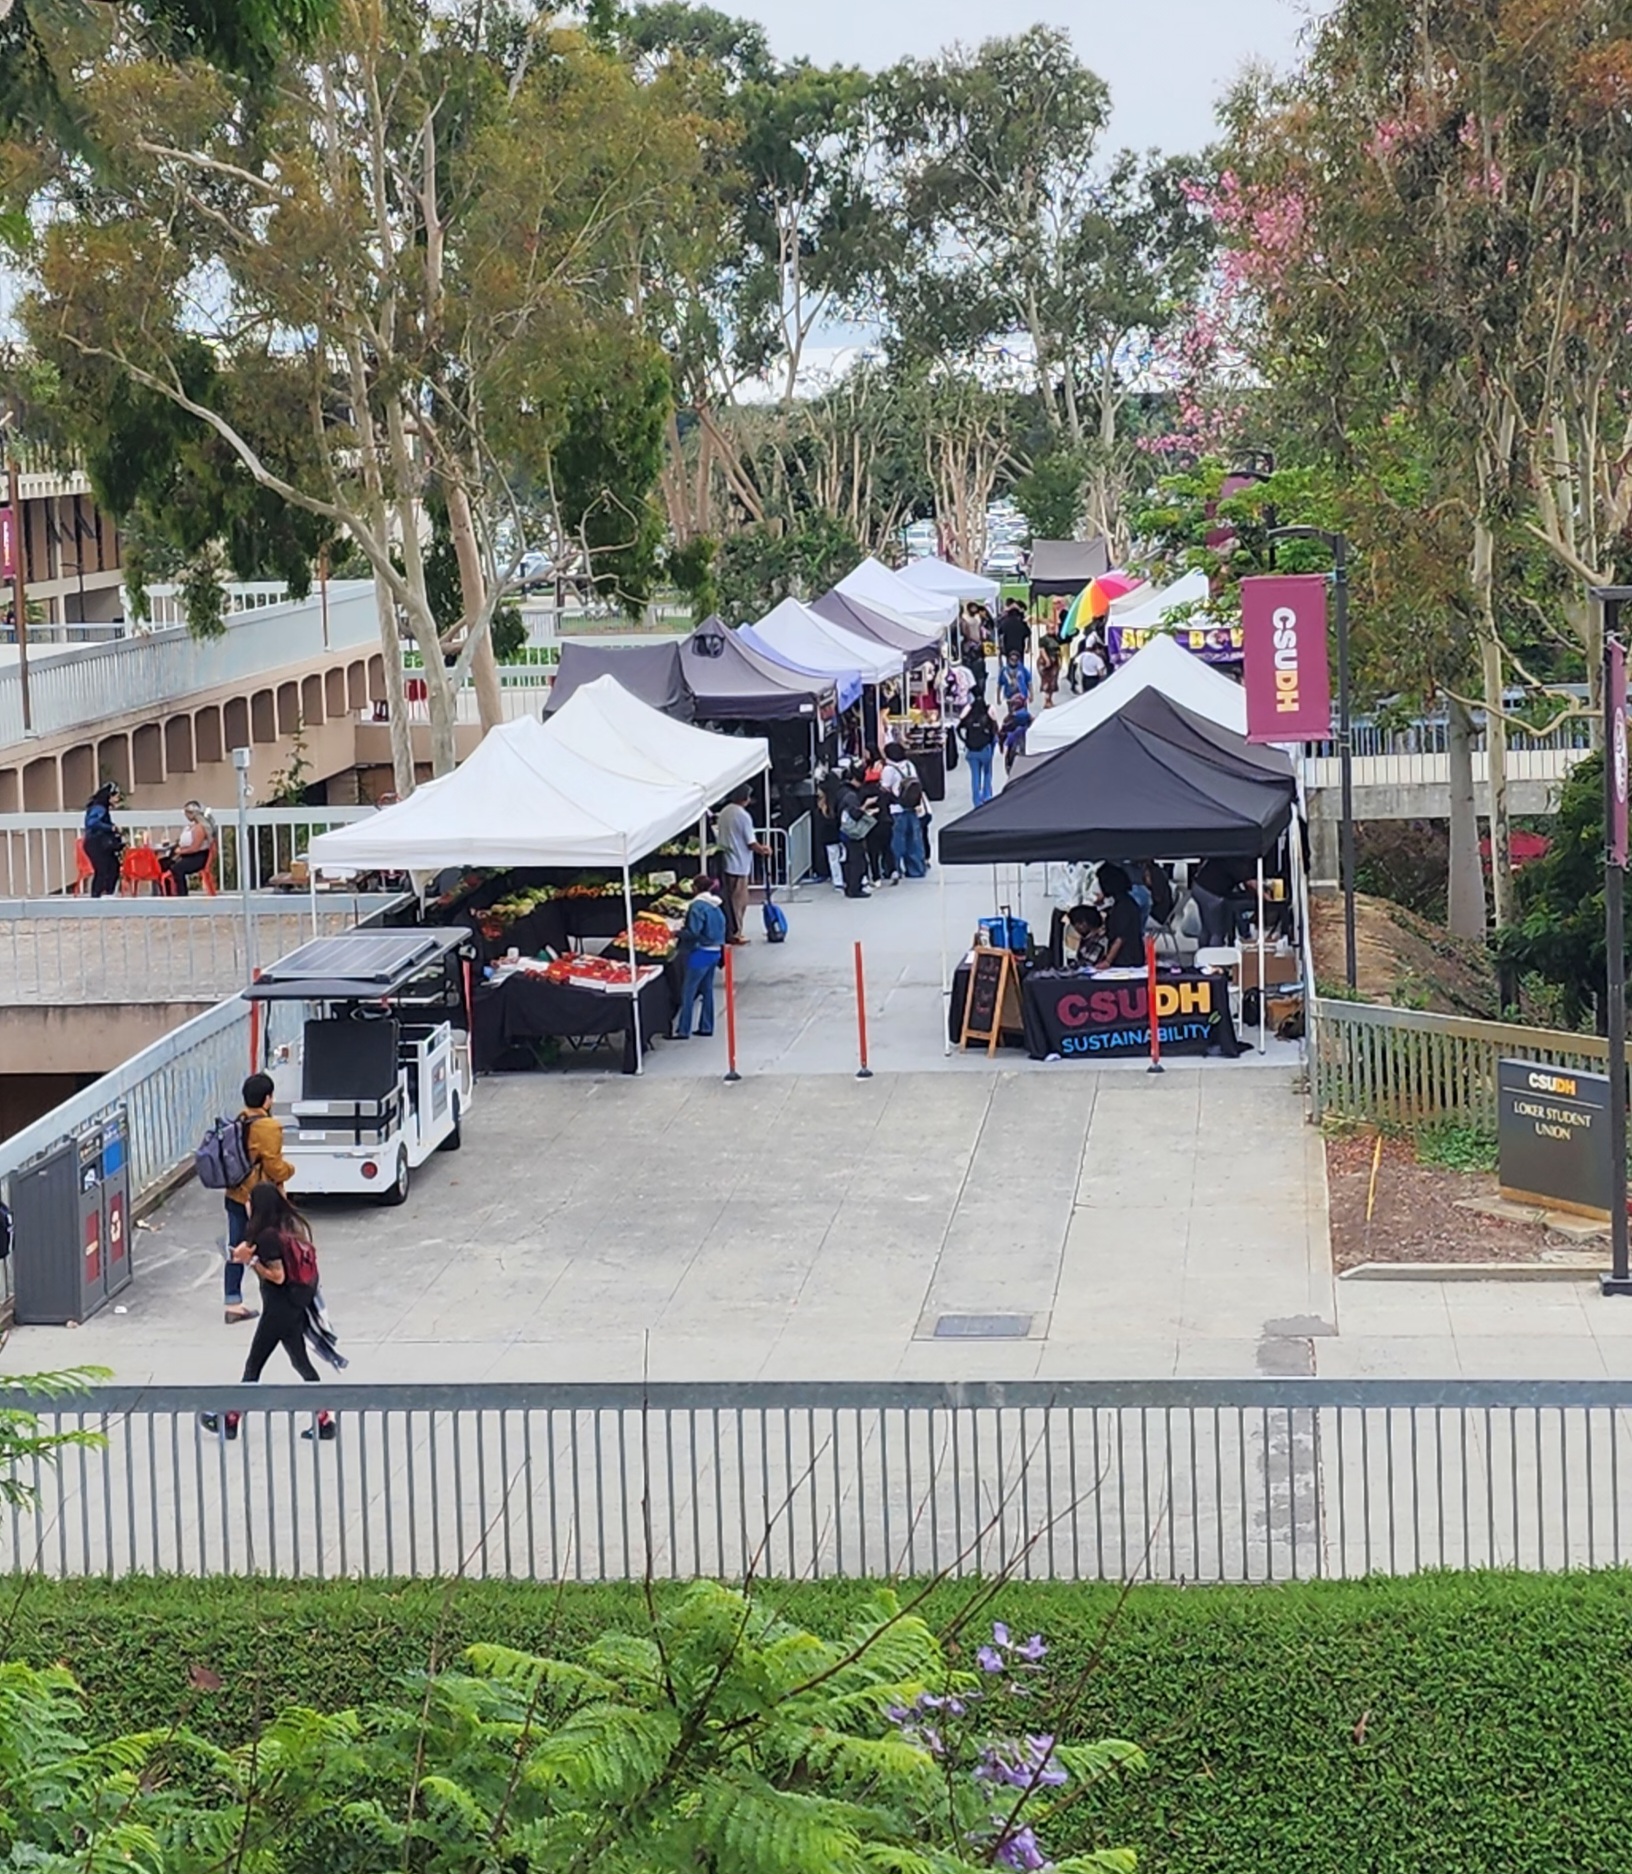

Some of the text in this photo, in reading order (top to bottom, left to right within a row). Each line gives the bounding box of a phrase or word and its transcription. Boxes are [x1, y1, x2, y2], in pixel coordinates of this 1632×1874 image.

[1272, 607, 1299, 712] CSUDH
[1057, 981, 1211, 1026] CSUDH
[1061, 1023, 1211, 1053] SUSTAINABILITY
[1529, 1072, 1576, 1095] CSUDH
[1514, 1101, 1591, 1127] LOKER STUDENT
[1535, 1122, 1571, 1139] UNION
